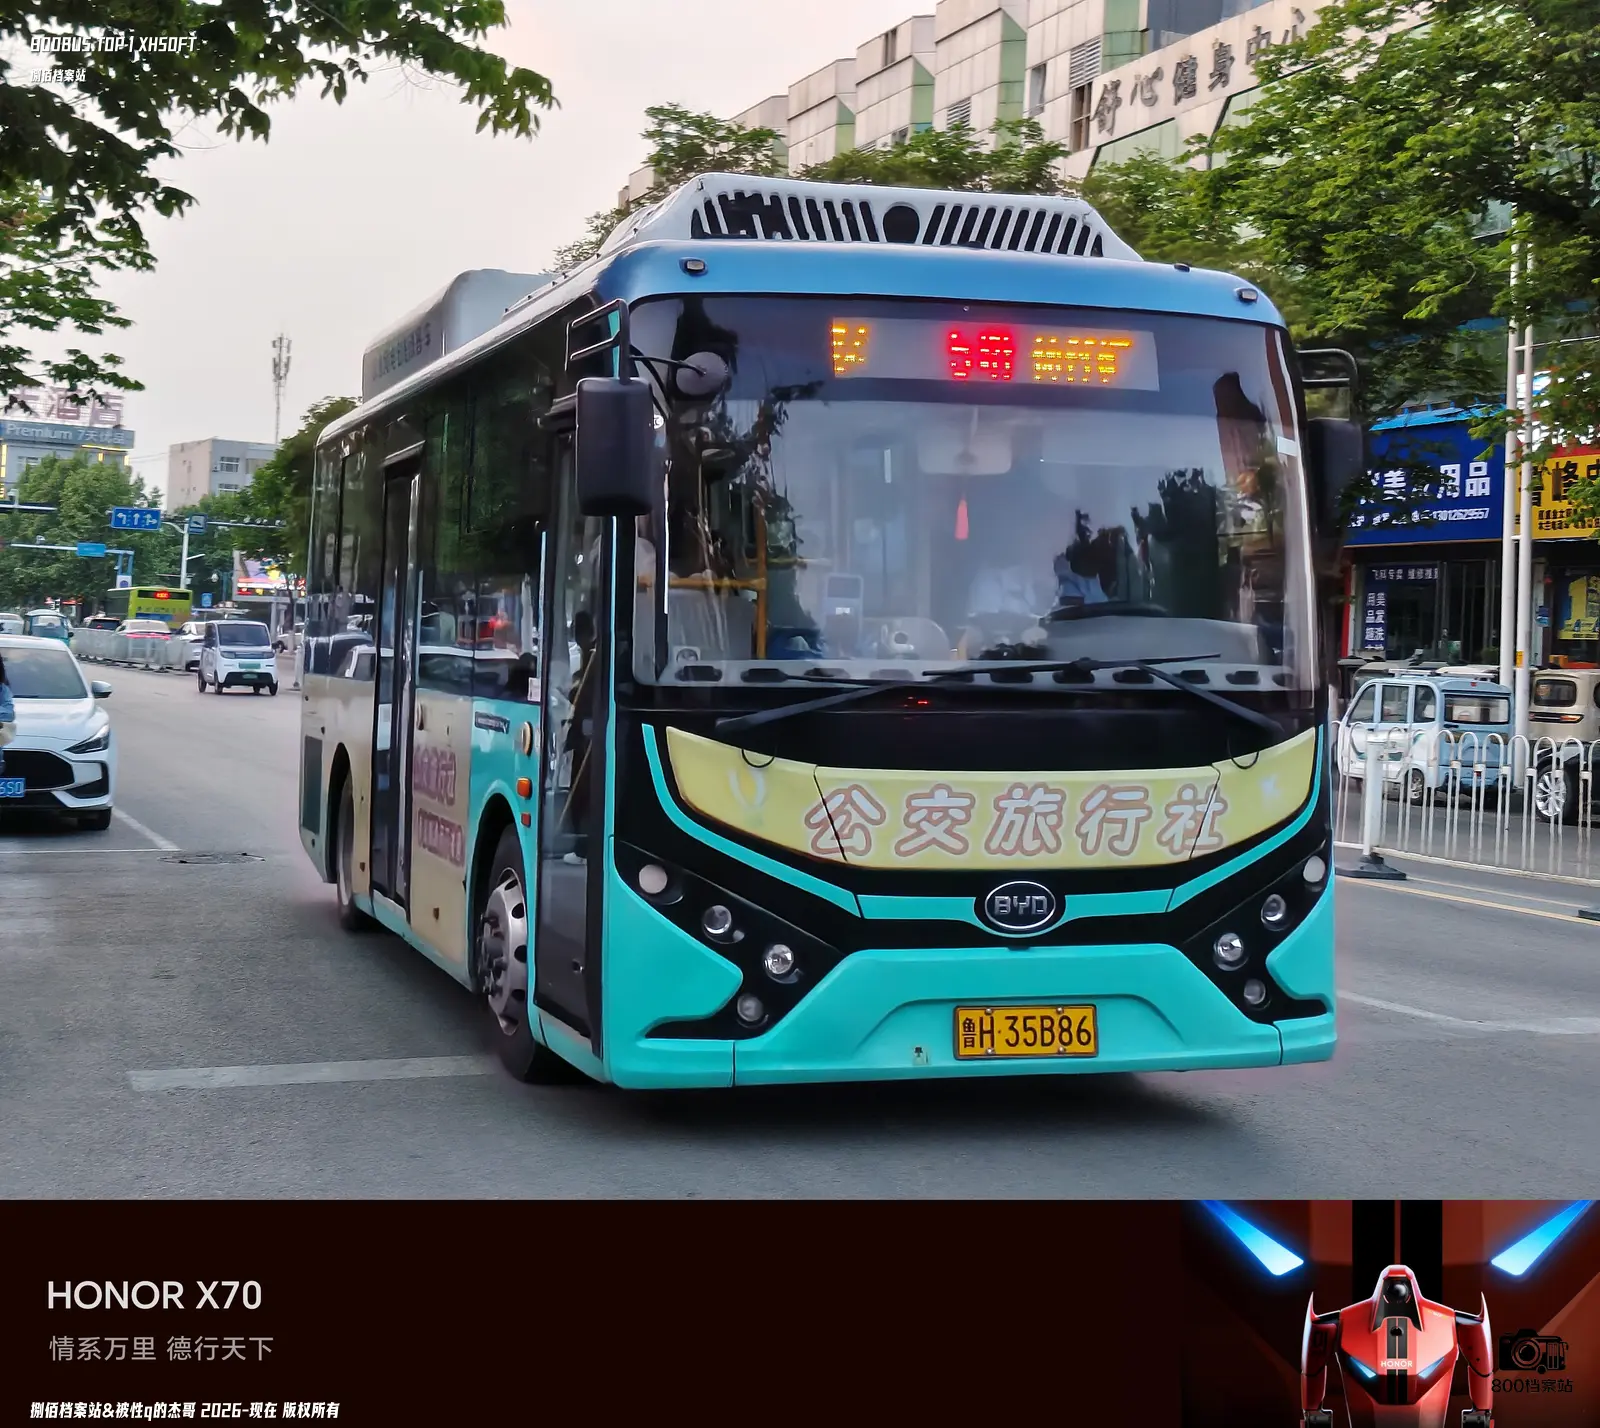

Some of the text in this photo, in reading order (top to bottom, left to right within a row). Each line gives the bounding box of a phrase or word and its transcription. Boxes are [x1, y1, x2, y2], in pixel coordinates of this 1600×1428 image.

[804, 783, 1229, 857] 公交旅行社
[994, 895, 1048, 916] BYD
